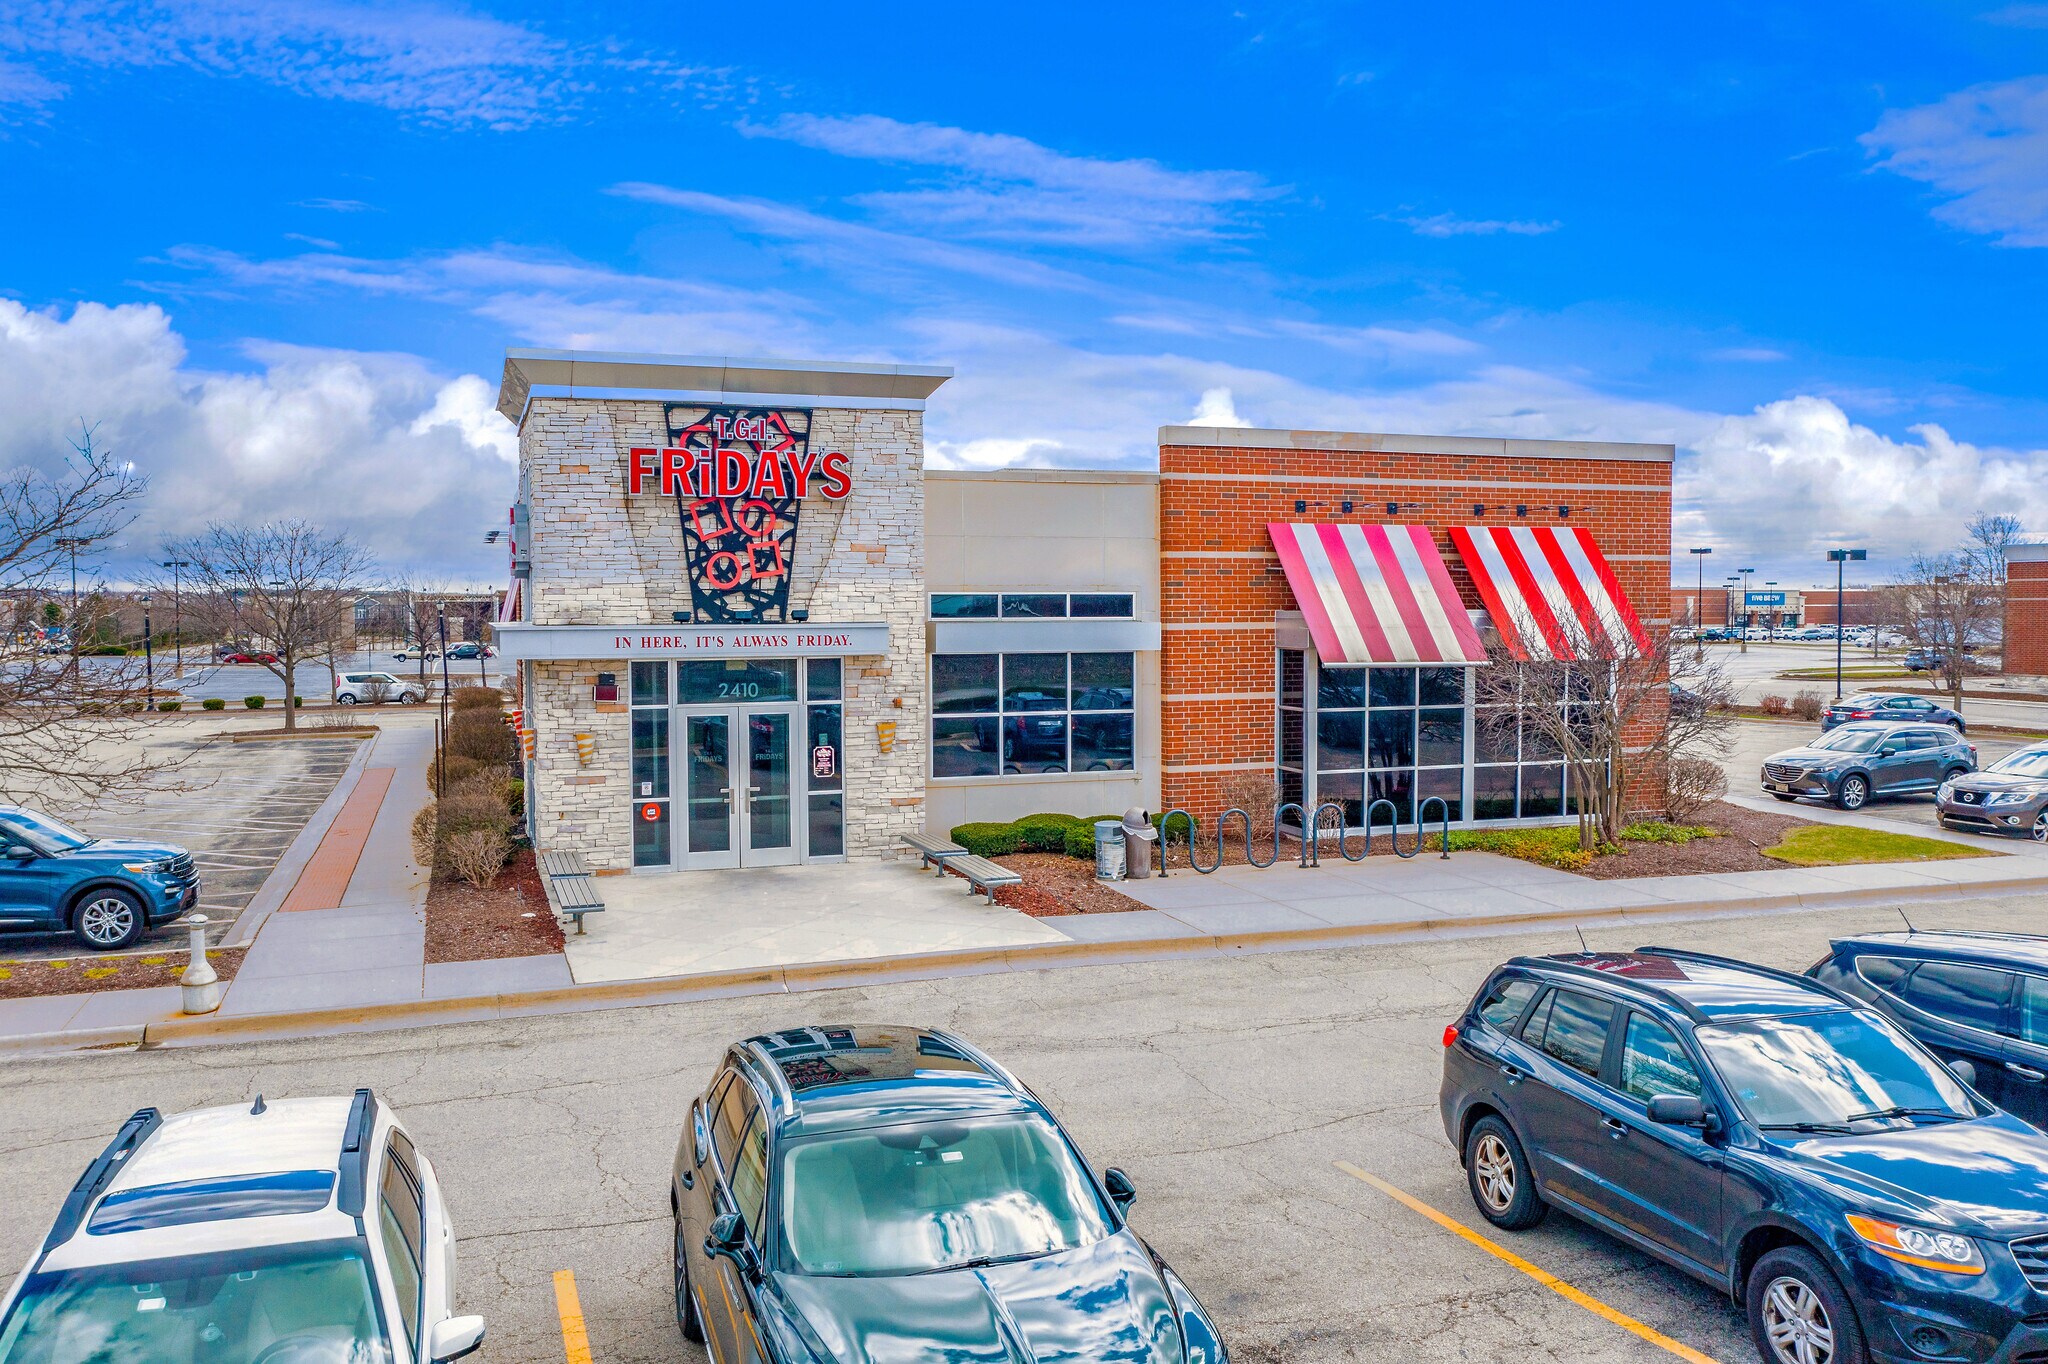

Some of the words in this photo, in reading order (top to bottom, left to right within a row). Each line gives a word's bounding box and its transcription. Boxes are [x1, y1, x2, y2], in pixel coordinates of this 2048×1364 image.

[714, 417, 773, 440] T.G.I.
[615, 637, 632, 649] IN
[641, 636, 687, 649] HERE,
[696, 636, 724, 648] IT'S
[732, 635, 788, 648] ALWAYS
[797, 634, 852, 646] FRIDAY.
[718, 682, 759, 698] 2410
